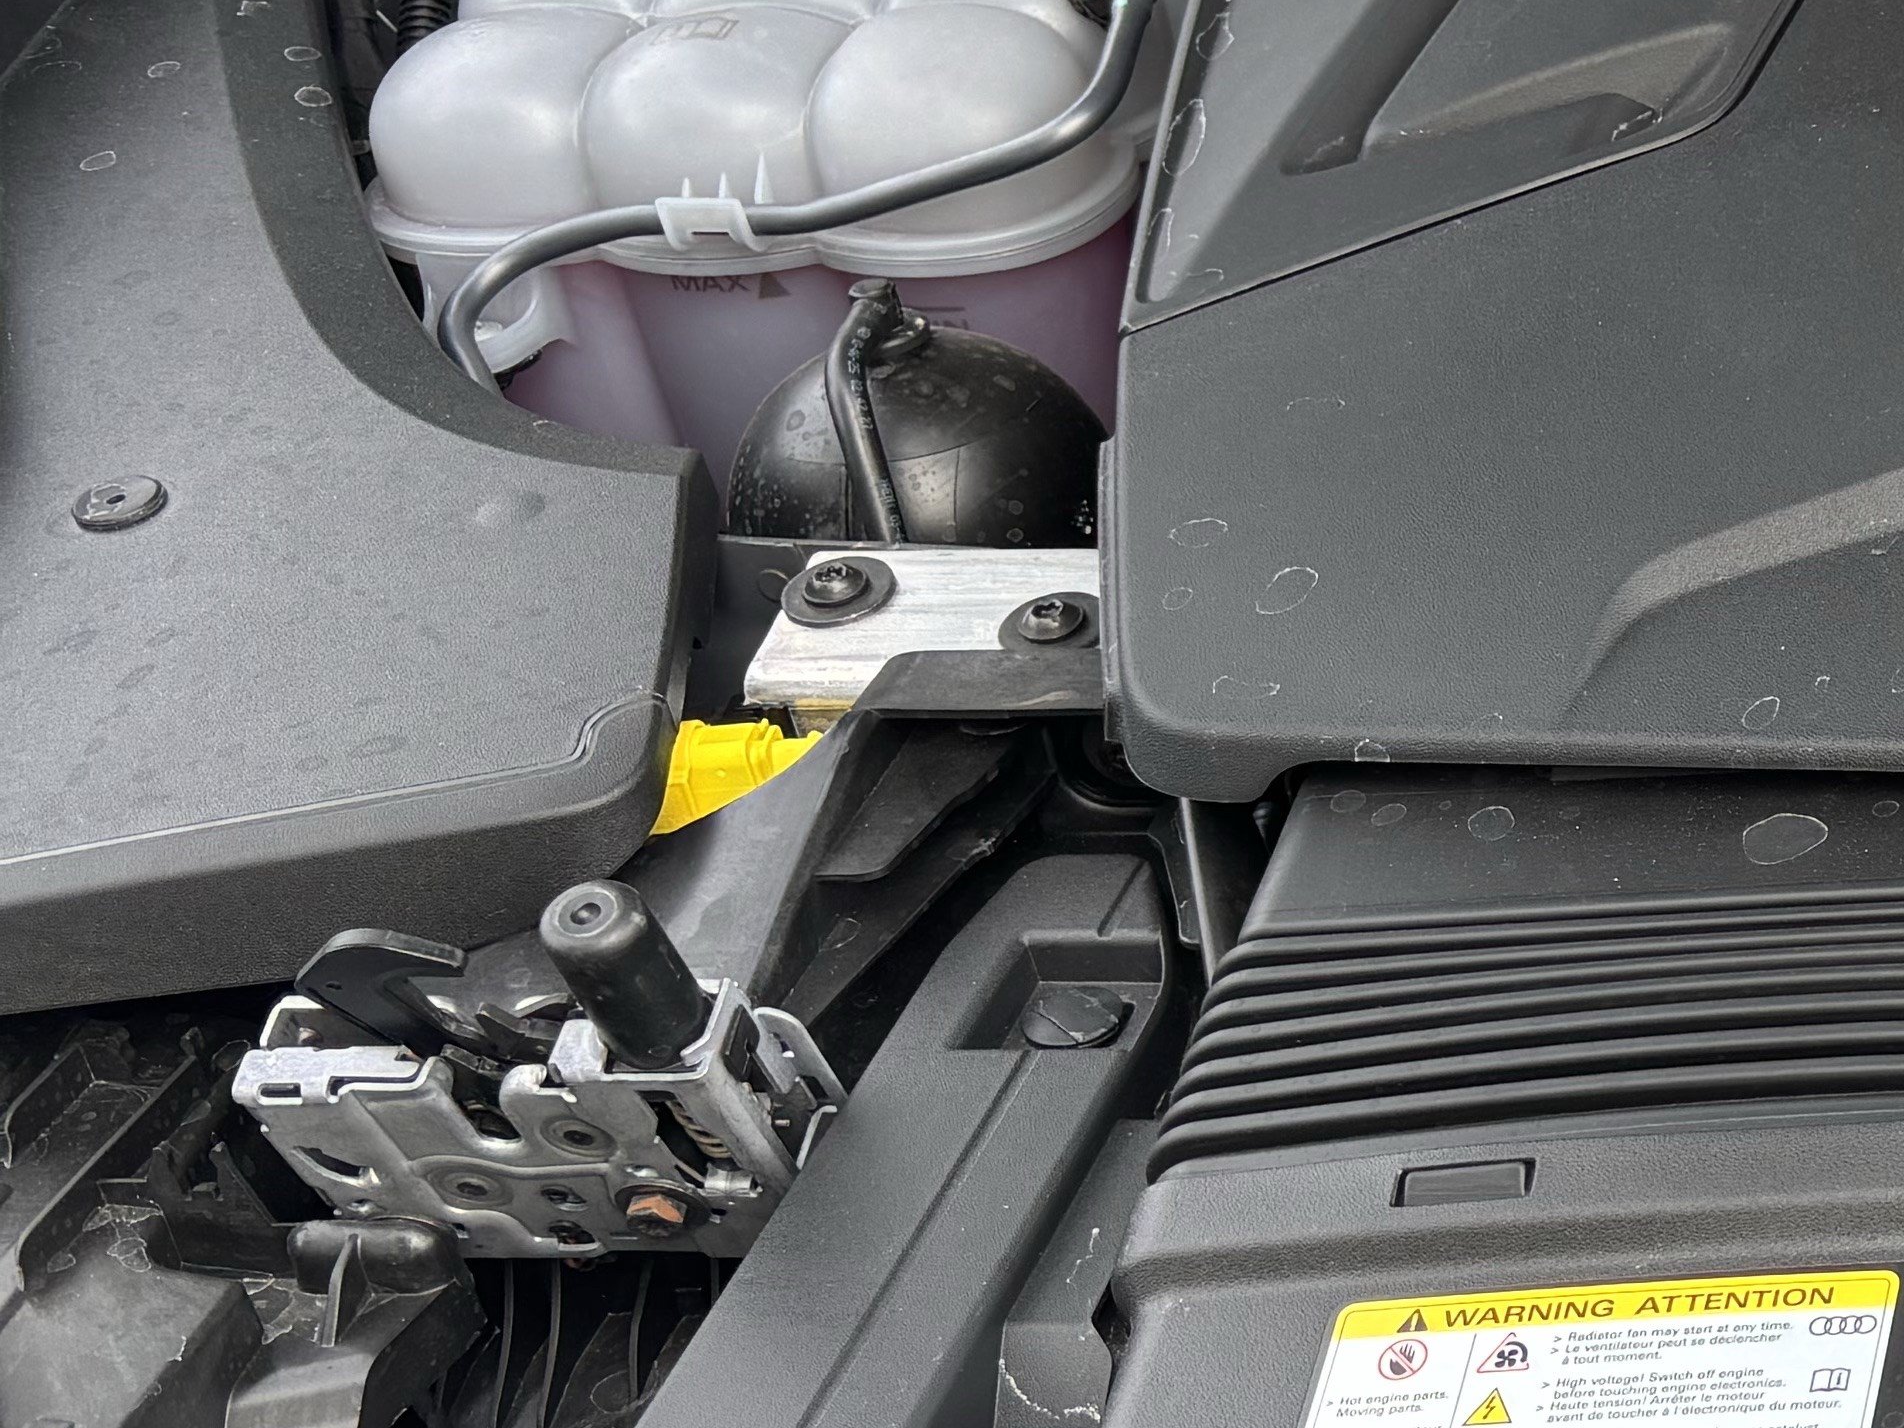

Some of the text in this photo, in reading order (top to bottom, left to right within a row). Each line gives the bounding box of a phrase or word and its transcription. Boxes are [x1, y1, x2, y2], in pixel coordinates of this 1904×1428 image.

[1445, 1286, 1836, 1328] WARNING ATTENTION
[1568, 1321, 1793, 1342] Radiator fan may start at any time.
[1565, 1343, 1580, 1353] Le
[1585, 1340, 1653, 1352] ventilateur
[1657, 1338, 1687, 1349] peut
[1691, 1337, 1705, 1346] se
[1574, 1353, 1601, 1364] tout
[1604, 1351, 1662, 1362] moment.
[1556, 1377, 1587, 1389] High
[1648, 1370, 1693, 1382] Switch
[1697, 1369, 1716, 1379] off
[1718, 1368, 1764, 1379] engine
[1340, 1397, 1362, 1405] Hot
[1366, 1393, 1410, 1404] engine
[1554, 1387, 1596, 1399] before
[1599, 1386, 1657, 1398] touching
[1661, 1382, 1706, 1394] engine
[1550, 1401, 1589, 1411] Haute
[1701, 1394, 1712, 1403] le
[1716, 1391, 1765, 1401] moteur
[1336, 1406, 1385, 1417] Moving
[1547, 1412, 1583, 1423] avant
[1588, 1410, 1604, 1420] de
[1608, 1408, 1657, 1419] toucher
[1769, 1400, 1787, 1410] du
